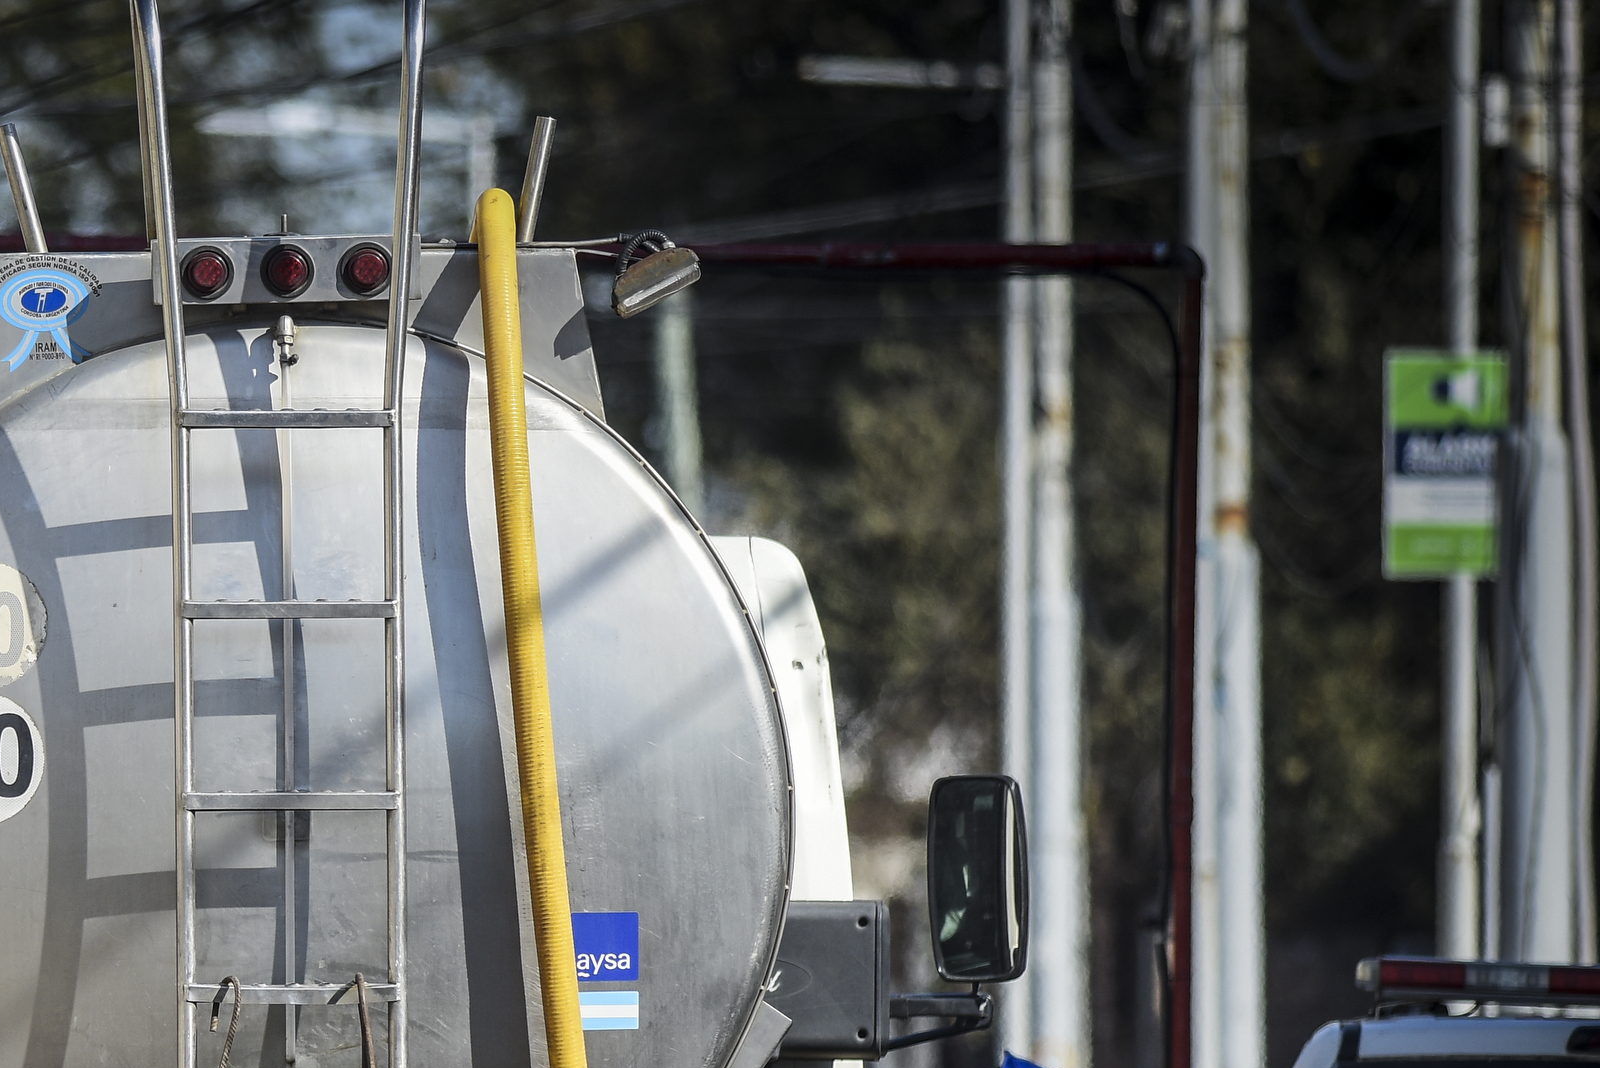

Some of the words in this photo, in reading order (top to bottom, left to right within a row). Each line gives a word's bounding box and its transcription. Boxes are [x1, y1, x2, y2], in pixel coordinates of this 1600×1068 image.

[15, 258, 25, 266] DE
[58, 257, 68, 265] DE
[69, 260, 78, 268] LA
[79, 265, 103, 290] CALIDAD
[53, 263, 77, 275] NORMA
[78, 272, 89, 283] ISO
[88, 281, 101, 298] 9001
[35, 342, 57, 352] IRAM
[576, 952, 631, 977] aysa
